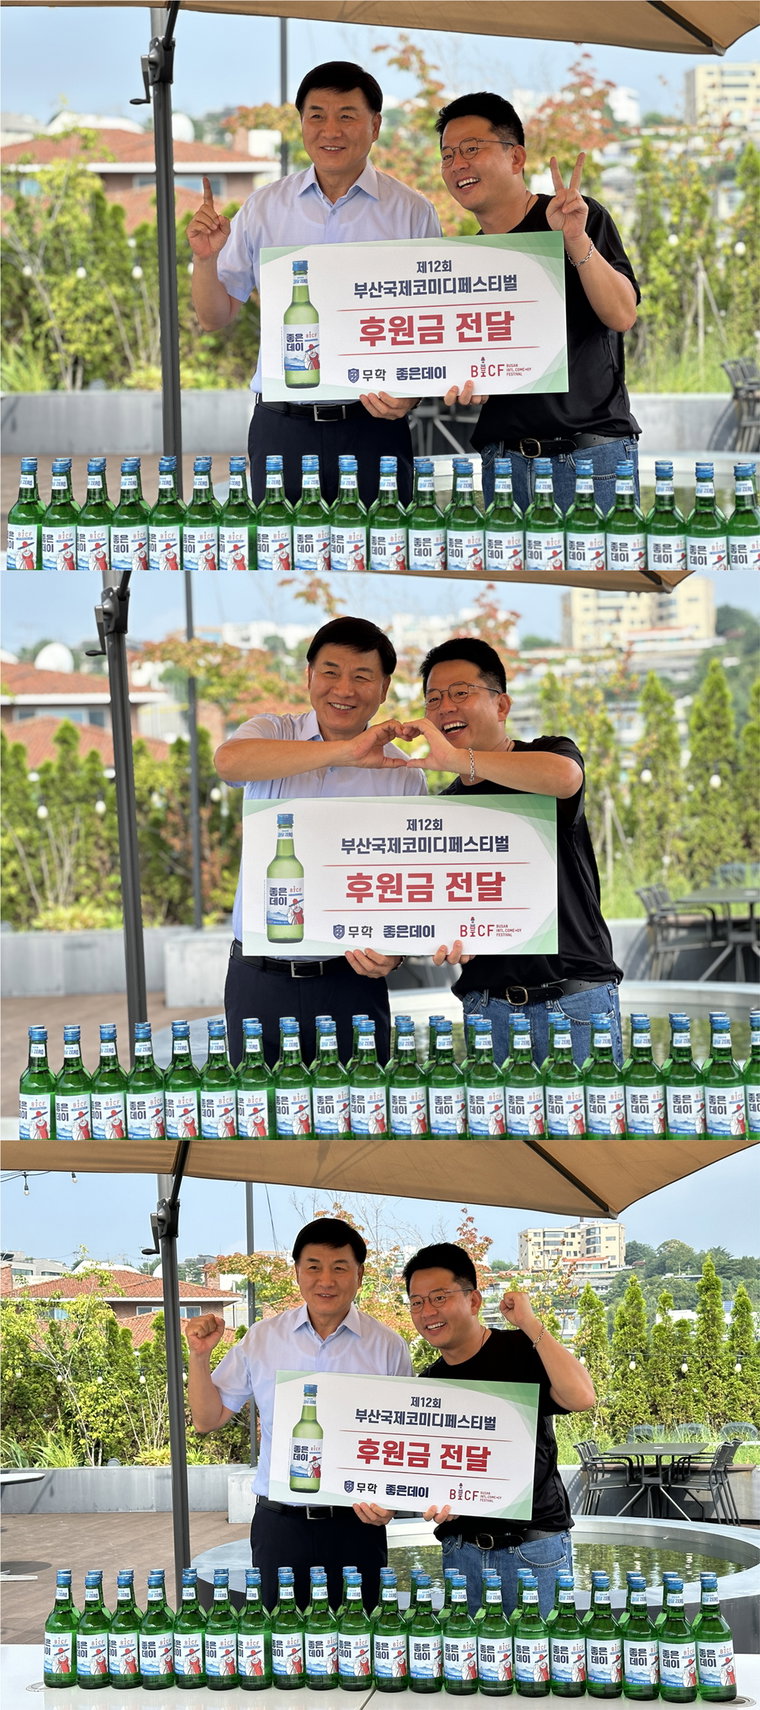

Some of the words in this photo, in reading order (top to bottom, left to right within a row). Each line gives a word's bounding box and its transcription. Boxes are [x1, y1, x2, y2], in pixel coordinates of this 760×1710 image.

[416, 259, 452, 274] 제12회
[353, 274, 518, 299] 부산국제코미디페스티벌
[359, 313, 446, 347] 후원금
[455, 310, 516, 343] 전달
[286, 333, 304, 343] 좋은
[286, 343, 304, 352] 데이
[471, 356, 505, 378] BICF
[362, 368, 386, 382] 무학
[396, 366, 447, 381] 좋은데이
[113, 544, 129, 553] 데이
[257, 544, 270, 553] 데이
[297, 544, 314, 553] 데이
[331, 544, 345, 554] 데이
[372, 546, 386, 555] 데이
[414, 547, 432, 557] 데이
[449, 549, 463, 558] 데이
[488, 550, 503, 560] 데이
[527, 550, 543, 560] 데이
[568, 551, 585, 561] 데이
[611, 552, 629, 562] 데이
[653, 553, 673, 564] 데이
[731, 554, 748, 565] 데이
[690, 556, 707, 566] 데이
[406, 818, 443, 832] 제12회
[340, 835, 510, 855] 부산국제코미디페스티벌
[269, 887, 287, 896] 좋은
[345, 872, 435, 903] 후원금
[445, 871, 506, 902] 전달
[269, 897, 287, 906] 데이
[383, 924, 435, 938] 좋은데이
[460, 916, 495, 937] BICF
[348, 925, 373, 939] 무학
[202, 1109, 215, 1118] 데이
[276, 1105, 289, 1115] 데이
[318, 1105, 334, 1114] 데이
[351, 1105, 365, 1114] 데이
[392, 1105, 407, 1115] 데이
[435, 1105, 453, 1115] 데이
[469, 1105, 485, 1115] 데이
[508, 1105, 525, 1115] 데이
[549, 1105, 564, 1115] 데이
[589, 1105, 607, 1115] 데이
[631, 1105, 649, 1115] 데이
[673, 1105, 693, 1114] 데이
[709, 1106, 727, 1115] 데이
[130, 1111, 147, 1120] 데이
[410, 1396, 442, 1409] 제12회
[355, 1408, 497, 1431] 부산국제코미디페스티벌
[293, 1445, 309, 1453] 좋은
[293, 1453, 308, 1461] 데이
[356, 1438, 431, 1468] 후원금
[440, 1444, 492, 1473] 전달
[356, 1482, 378, 1495] 무학
[385, 1483, 429, 1498] 좋은데이
[449, 1482, 479, 1501] BICF
[142, 1650, 157, 1658] 데이
[272, 1649, 284, 1658] 데이
[308, 1650, 324, 1658] 데이
[338, 1650, 351, 1658] 데이
[375, 1651, 390, 1660] 데이
[414, 1652, 431, 1661] 데이
[445, 1653, 459, 1662] 데이
[480, 1654, 495, 1663] 데이
[516, 1655, 531, 1664] 데이
[553, 1655, 569, 1664] 데이
[591, 1656, 608, 1665] 데이
[630, 1657, 648, 1667] 데이
[663, 1659, 680, 1669] 데이
[699, 1658, 716, 1668] 데이
